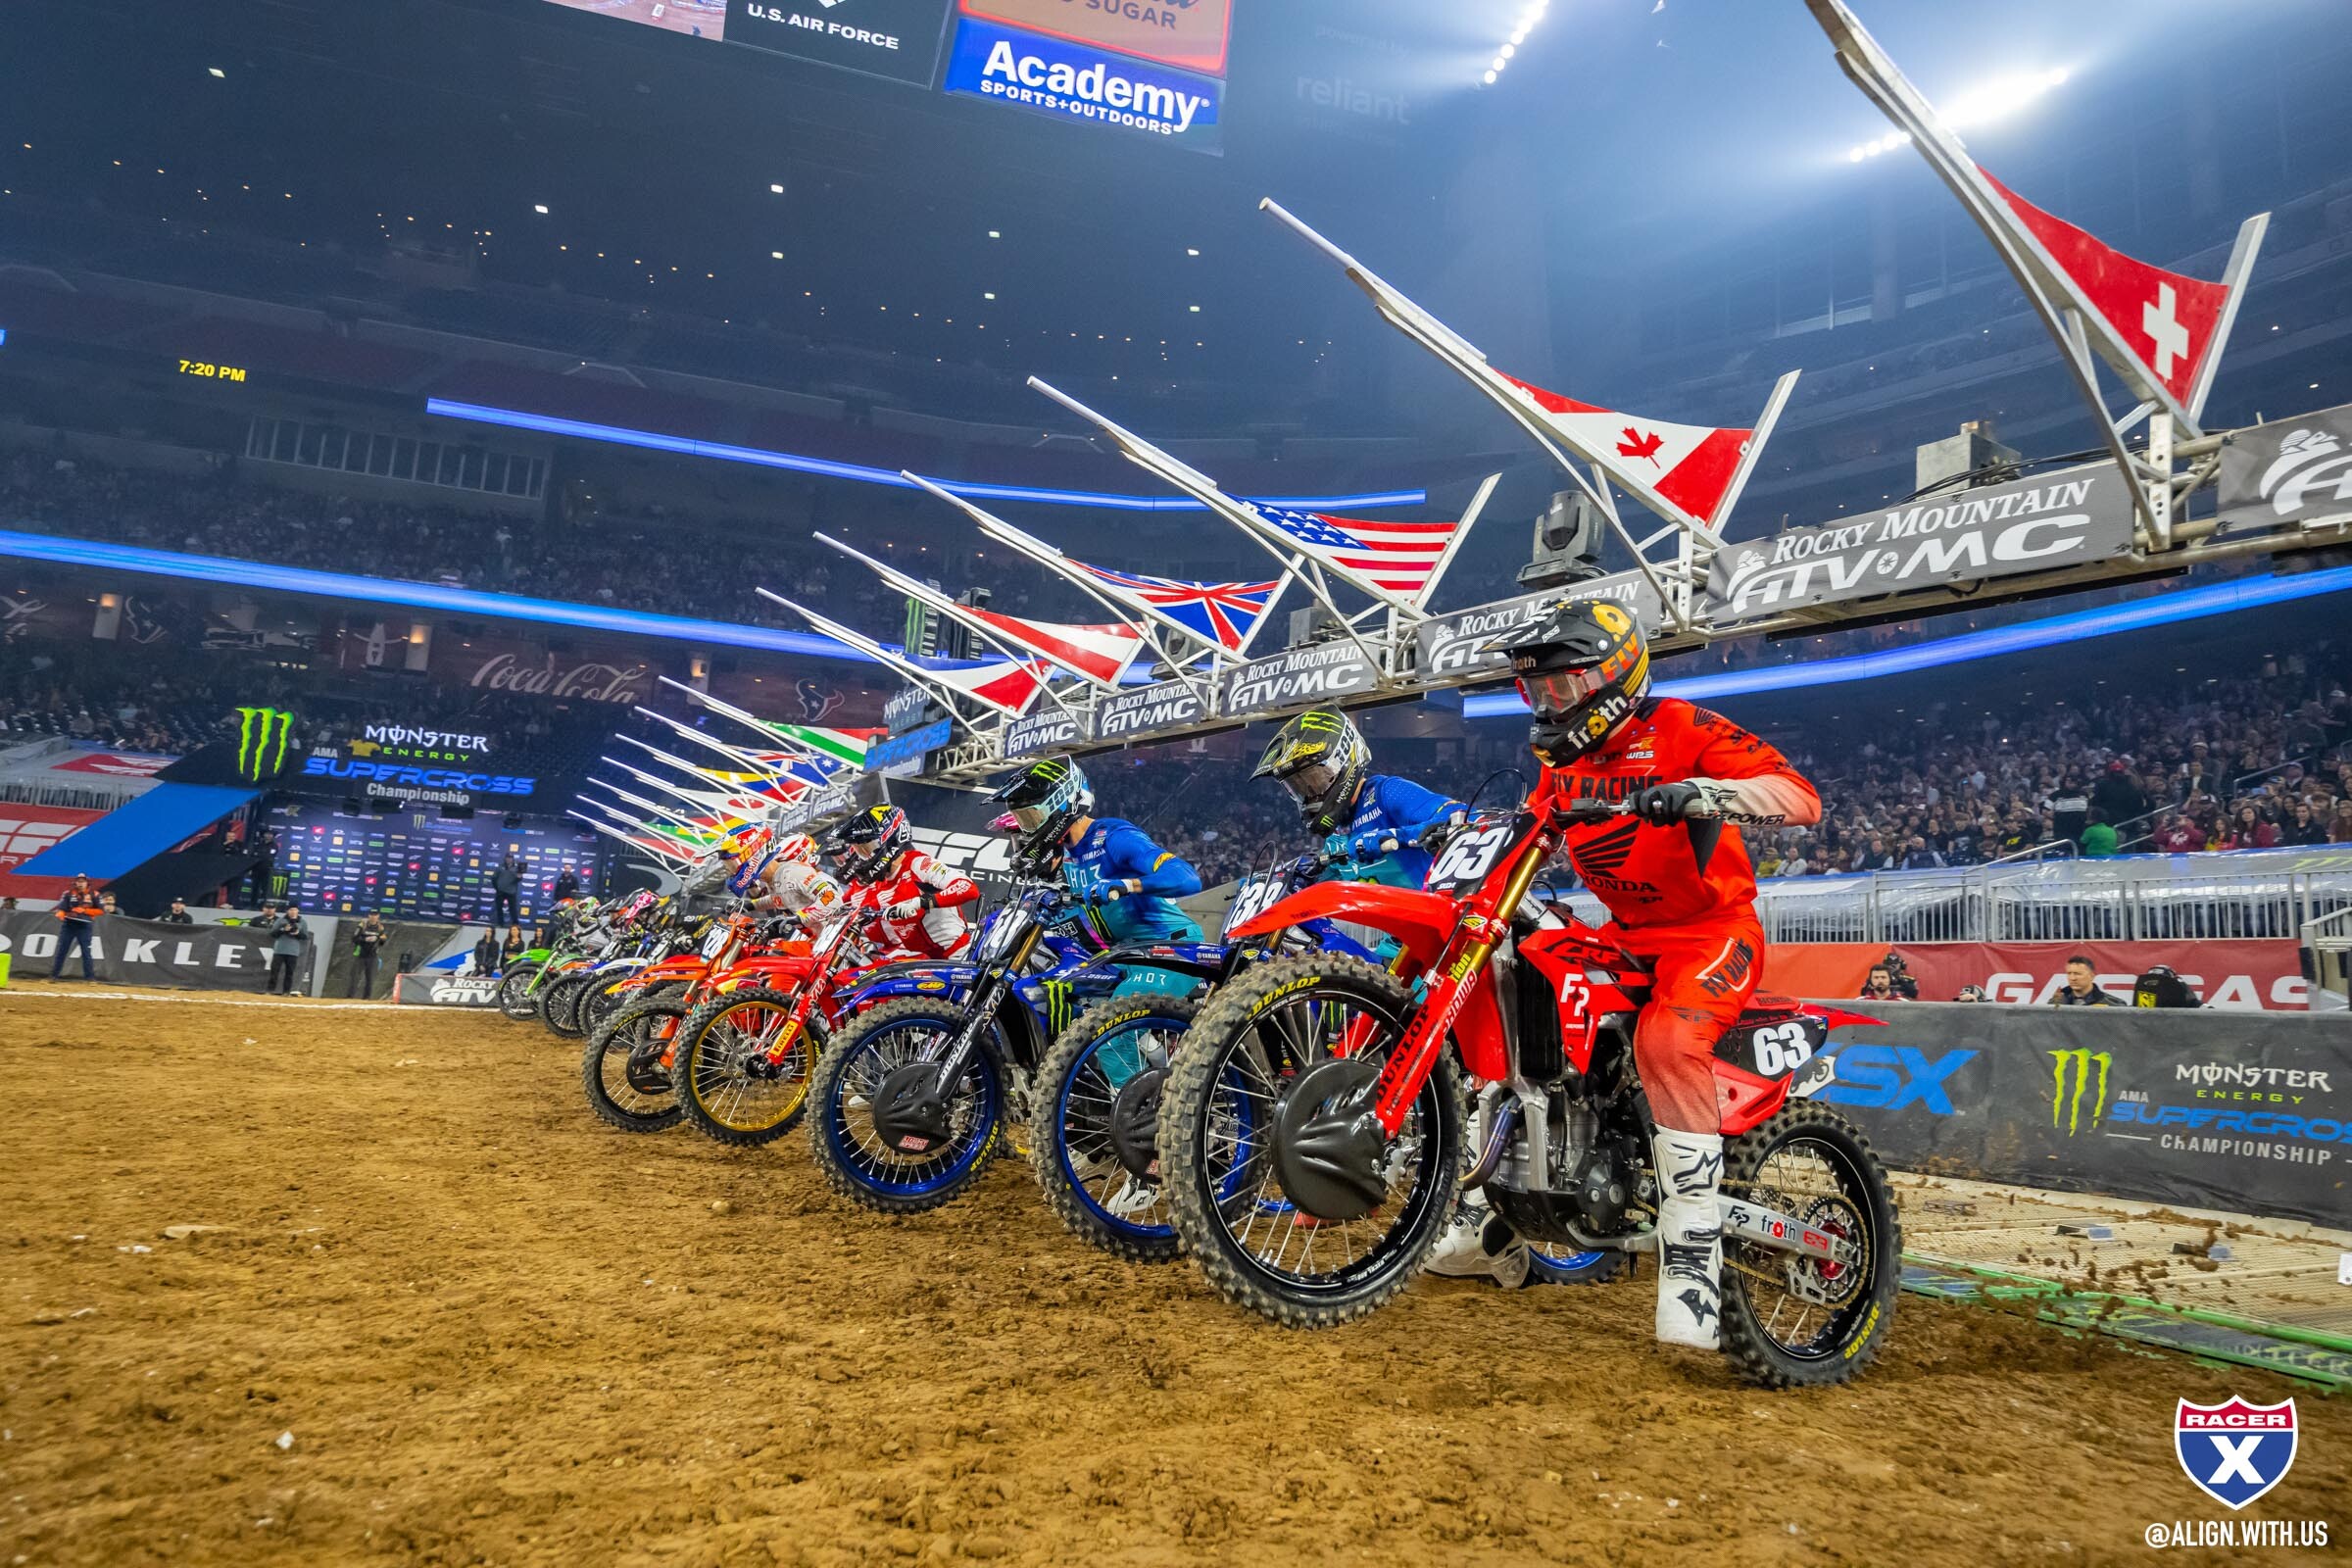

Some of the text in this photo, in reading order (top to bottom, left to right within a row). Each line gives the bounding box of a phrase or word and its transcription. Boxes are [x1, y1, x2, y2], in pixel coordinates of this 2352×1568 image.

[748, 3, 900, 50] U.S. AIR FORCE
[1085, 0, 1177, 29] SUGAR
[982, 40, 1200, 133] Academy
[1297, 76, 1409, 125] reliant
[980, 79, 1172, 135] SPORTS+OUTDOORS
[178, 359, 245, 382] 7:20 PM
[1770, 478, 2095, 565] ROCKY MOUNTAIN
[1731, 548, 1881, 614] ATV
[1457, 609, 1520, 637] ROCKY
[1247, 645, 1364, 683] ROCKY MOUNTAIN
[1598, 632, 1641, 683] FLY
[1115, 681, 1200, 711] ROCKY MOUNTAI
[1230, 677, 1286, 712] ATV
[312, 747, 338, 759] AMA
[365, 724, 489, 753] MONSTER
[383, 747, 469, 761] ENERGY
[302, 758, 537, 795] SUPERCROSS
[367, 782, 469, 806] Championship
[1428, 826, 1510, 881] 63
[453, 978, 495, 990] ROCKY
[1252, 976, 1321, 1016] DUNLOP
[1097, 1008, 1151, 1039] DUNLOP
[1376, 1004, 1431, 1103] DUNLOP
[1752, 1022, 1812, 1077] 63
[2176, 1062, 2333, 1093] MONSTER
[2118, 1090, 2149, 1103] AMA
[2196, 1089, 2305, 1104] ENERGY
[970, 1127, 999, 1172] DUNLOP
[2160, 1133, 2331, 1166] CHAMPIONSHIP
[1761, 1214, 1797, 1242] froth
[1844, 1307, 1881, 1360] DUNLOP
